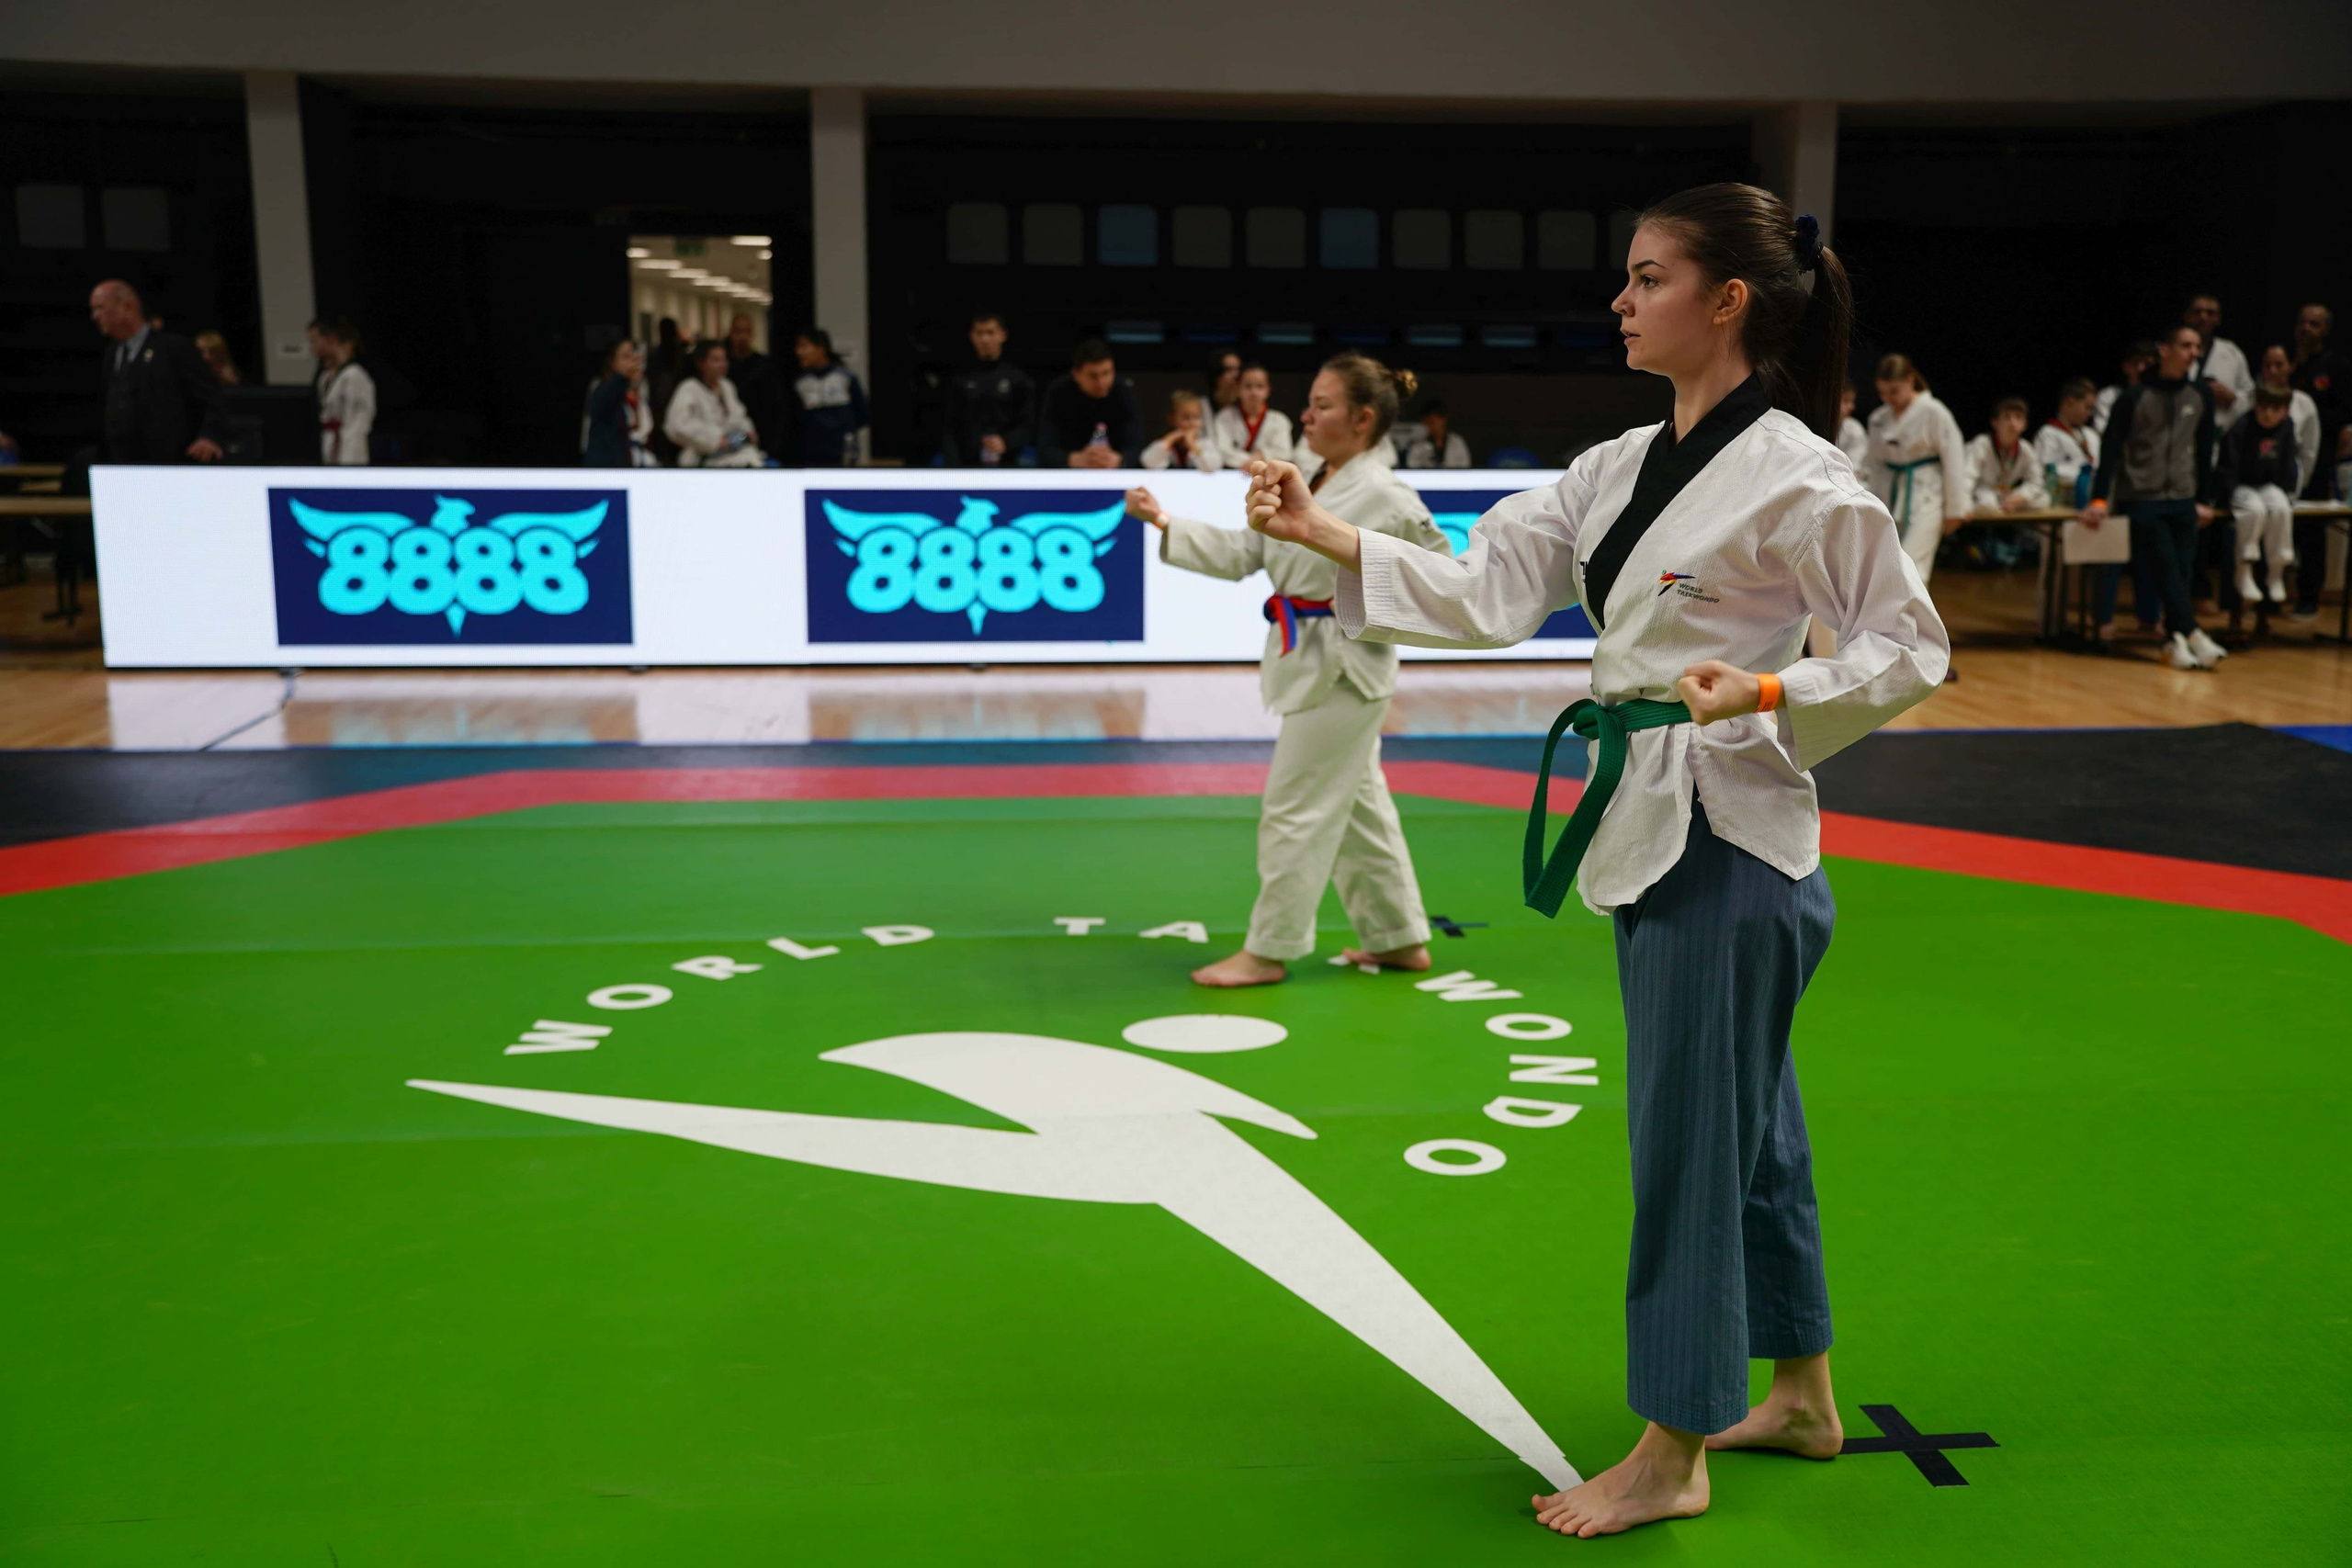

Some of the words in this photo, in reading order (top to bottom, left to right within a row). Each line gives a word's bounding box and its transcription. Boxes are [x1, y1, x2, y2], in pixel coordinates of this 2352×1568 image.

[318, 526, 590, 615] 8888
[846, 525, 1105, 614] 8888
[1677, 590, 1720, 603] TAEKWONDO
[1679, 582, 1703, 594] WORLD
[503, 924, 935, 1055] WORLD
[1054, 916, 1600, 1176] TAWONDO
